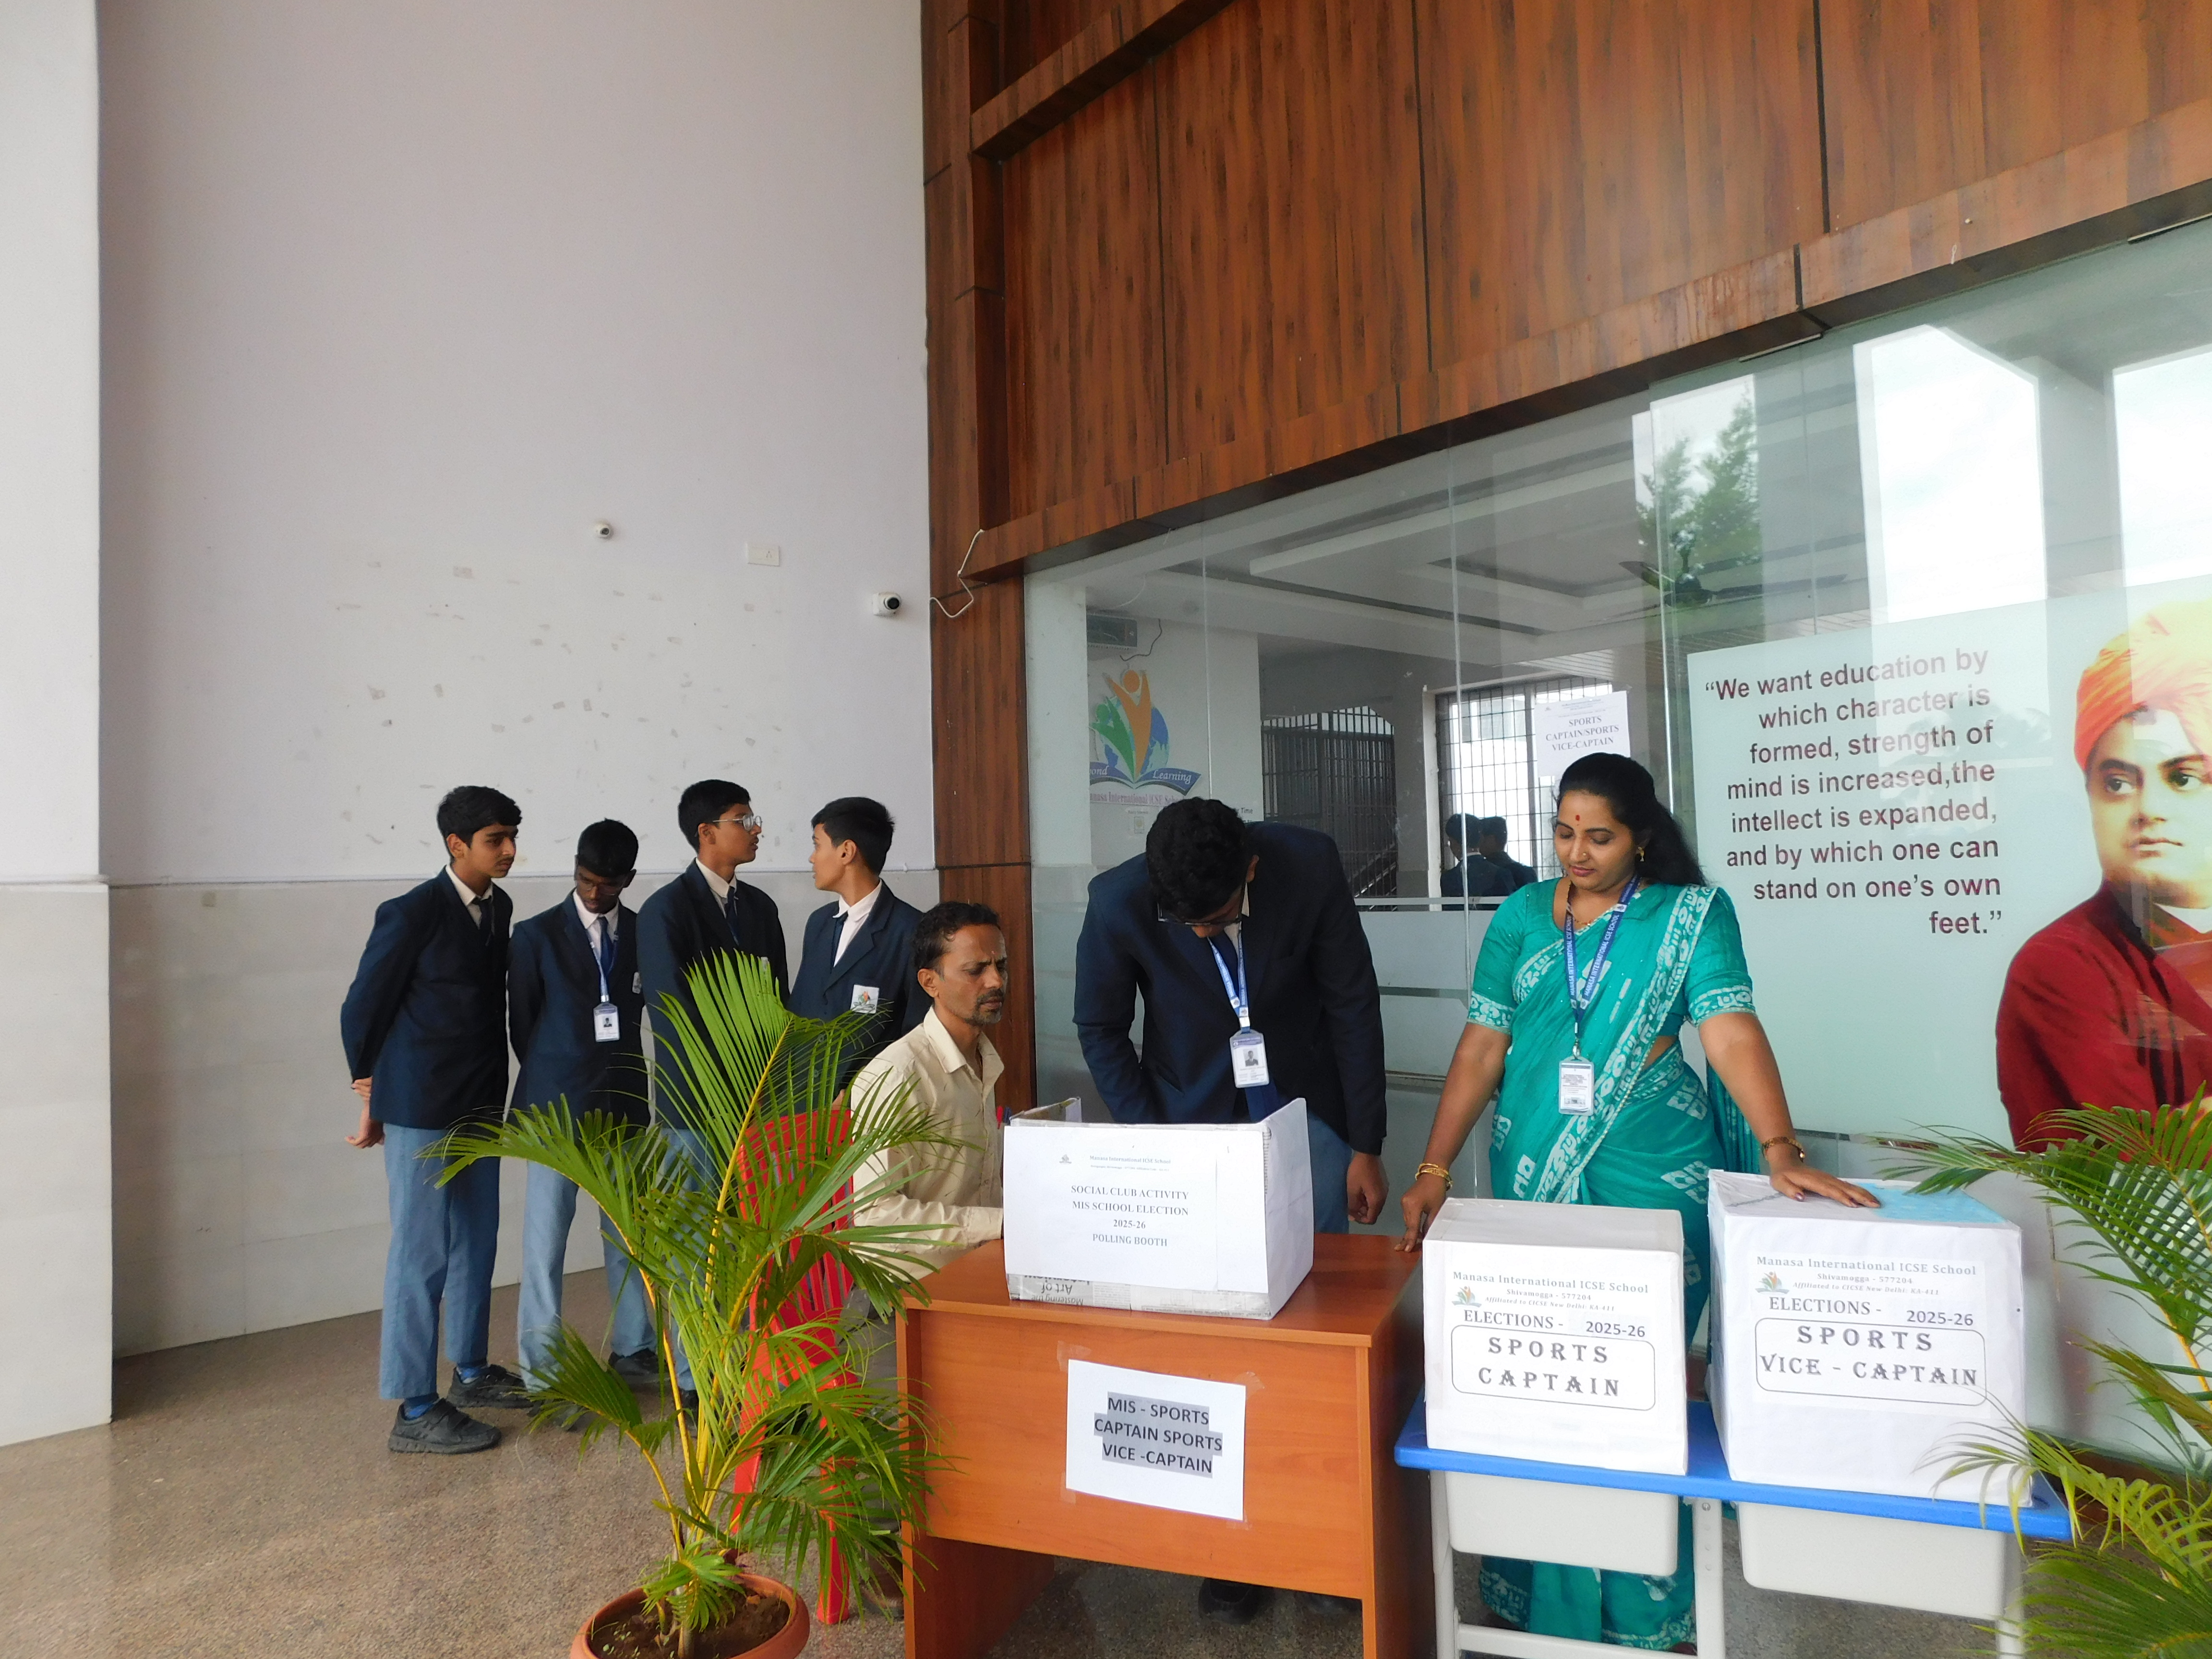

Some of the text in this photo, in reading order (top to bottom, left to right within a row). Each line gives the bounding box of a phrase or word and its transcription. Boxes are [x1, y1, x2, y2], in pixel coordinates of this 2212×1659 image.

[1706, 648, 1989, 700] “We want education by
[1759, 684, 1990, 729] which character is
[1569, 716, 1602, 727] SPORTS
[1552, 737, 1614, 751] VICE-CAPTAIN
[1750, 720, 1994, 764] formed, strength of
[1090, 766, 1191, 784] ond Learning
[1728, 777, 1782, 799] mind
[1791, 772, 1809, 794] is
[1108, 792, 1148, 804] International
[1732, 797, 1997, 832] intellect is expanded,
[1727, 837, 1999, 870] and by which one can
[1754, 874, 2001, 900] stand on one’s own
[1929, 910, 2002, 935] feet.”
[1585, 914, 1619, 996] MANASA INTERNATIONAL ICSE SCHOOL
[1071, 1185, 1189, 1200] SOCIAL CLUB ACTIVITY
[1072, 1201, 1189, 1215] MIS SCHOOL ELECTION
[1113, 1219, 1146, 1229] 2025-26
[1093, 1234, 1167, 1247] POLLING BOOTH
[1757, 1256, 1976, 1275] Manasa International ICSE School
[1041, 1283, 1072, 1295] Art of
[1453, 1272, 1648, 1293] Manasa International ICSE School
[1793, 1282, 1829, 1290] Affiliated
[1817, 1273, 1869, 1284] Shivamogga
[1046, 1294, 1083, 1306] Mastering
[1485, 1297, 1517, 1305] Affiliated
[1506, 1289, 1553, 1299] Shivamogga
[1769, 1297, 1871, 1315] ELECTIONS
[1907, 1310, 1973, 1326] 2025-26
[1464, 1310, 1553, 1329] ELECTIONS
[1586, 1321, 1645, 1337] 2025-26
[1797, 1325, 1932, 1351] SPORTS
[1488, 1337, 1608, 1363] SPORTS
[1479, 1367, 1619, 1396] CAPTAIN
[1760, 1354, 1821, 1376] VICE
[1853, 1362, 1977, 1386] CAPTAIN
[1108, 1397, 1136, 1413] MIS
[1150, 1405, 1209, 1425] SPORTS
[1094, 1419, 1222, 1451] CAPTAIN SPORTS
[1103, 1443, 1135, 1461] VICE
